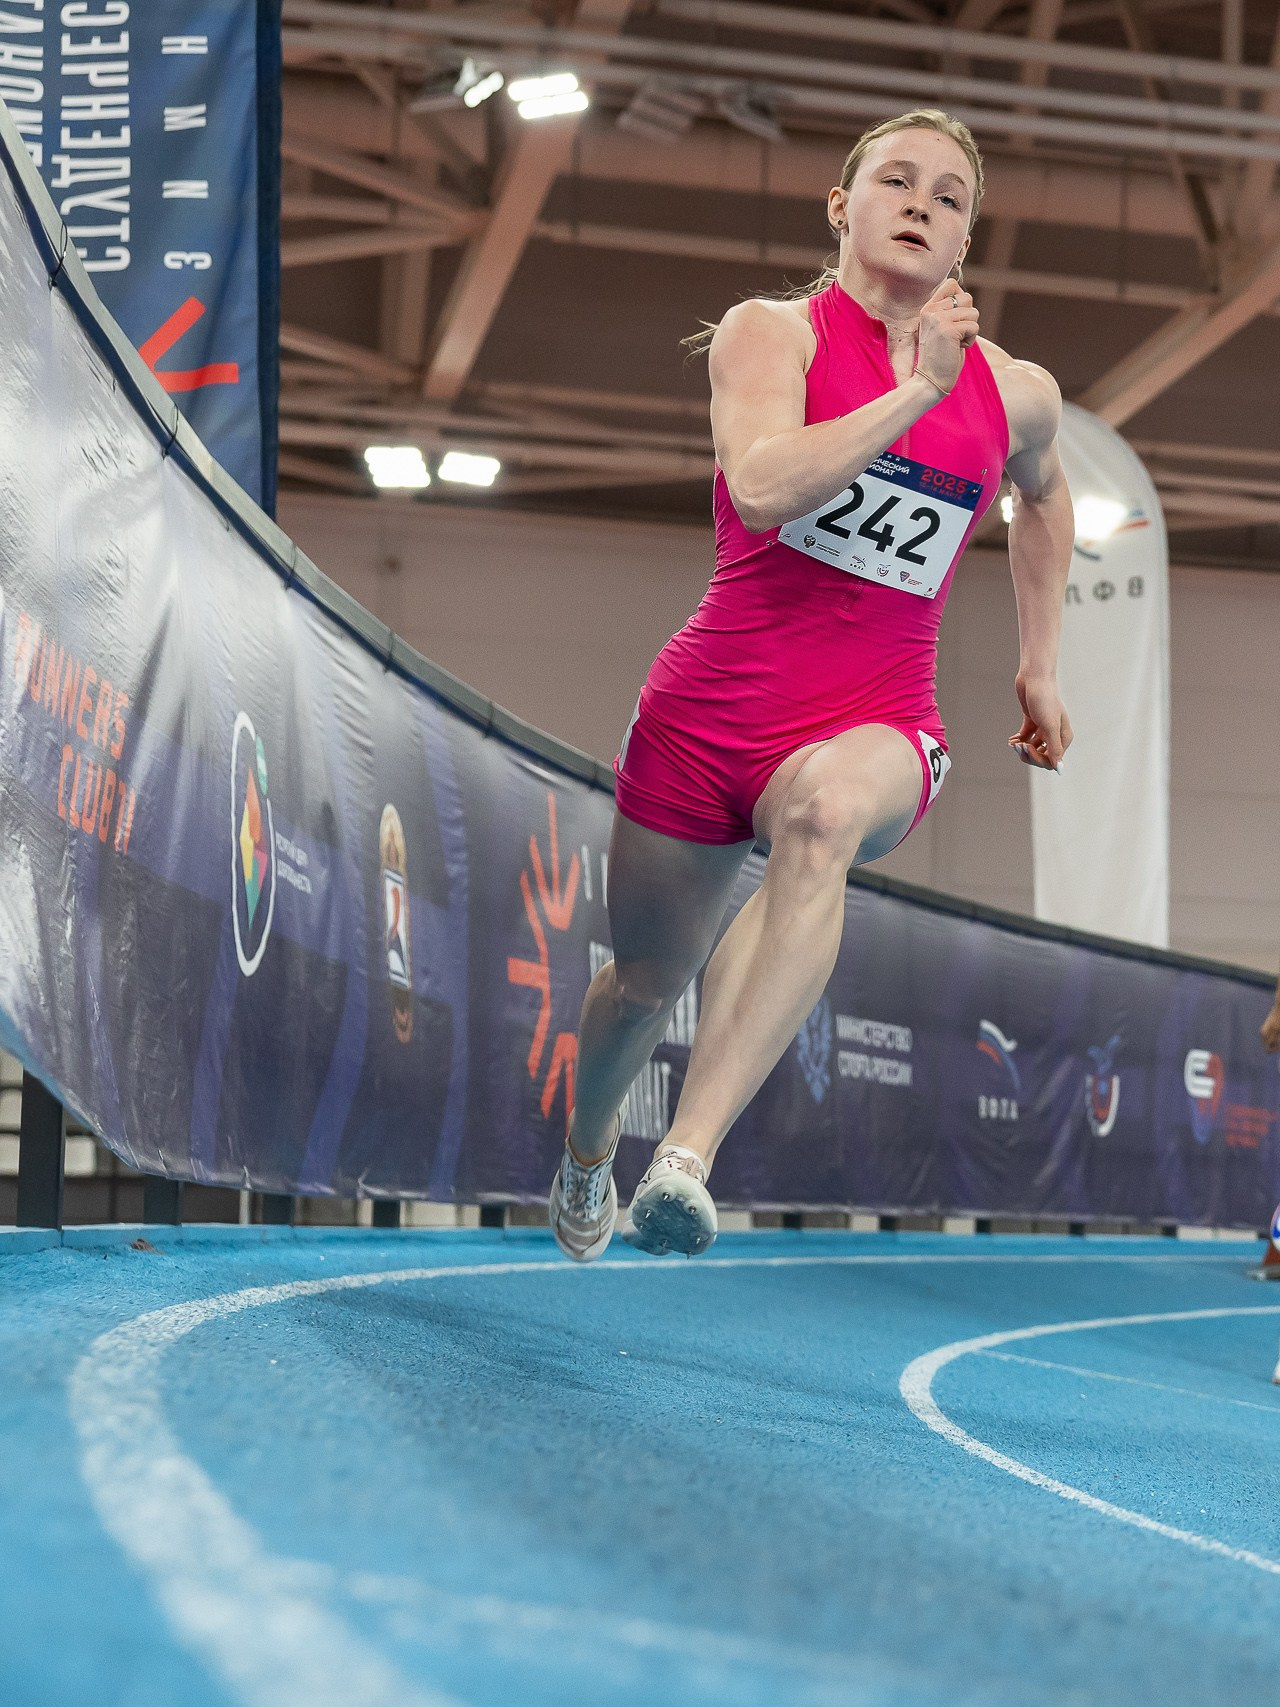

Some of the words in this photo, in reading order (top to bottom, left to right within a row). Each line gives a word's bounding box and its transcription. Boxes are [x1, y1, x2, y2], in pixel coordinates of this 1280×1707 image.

[814, 481, 941, 566] 242
[921, 468, 968, 494] 2025
[15, 611, 130, 760] RUNNERS
